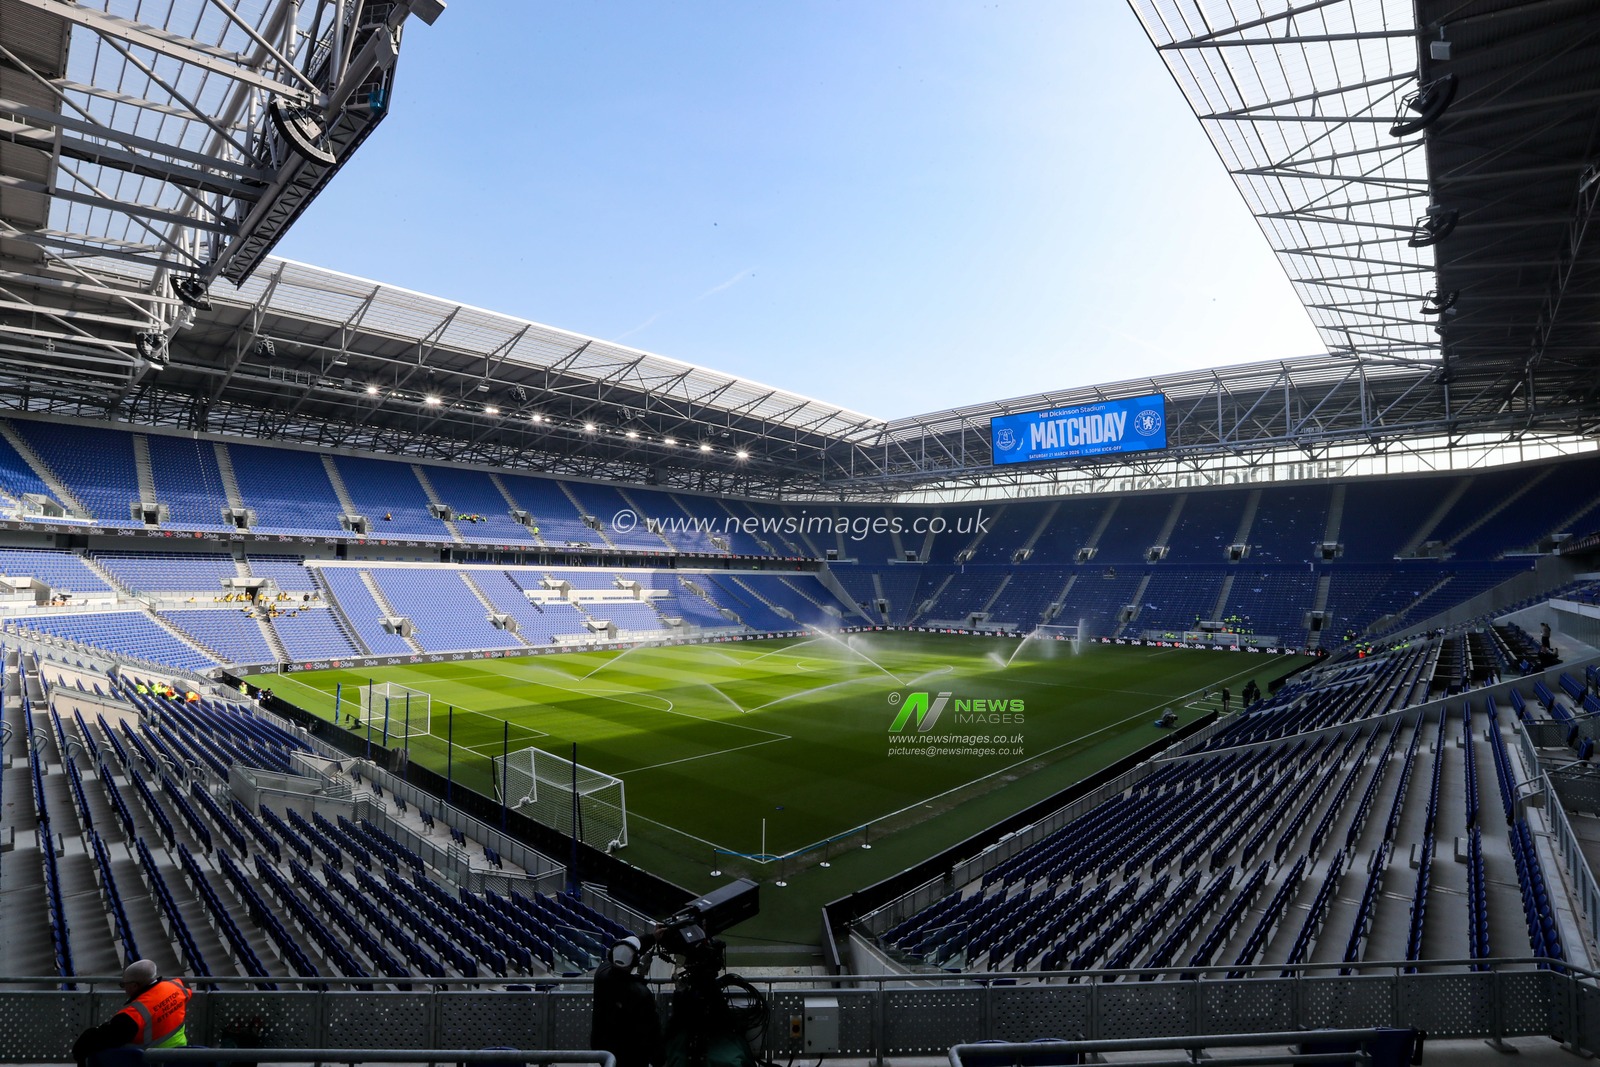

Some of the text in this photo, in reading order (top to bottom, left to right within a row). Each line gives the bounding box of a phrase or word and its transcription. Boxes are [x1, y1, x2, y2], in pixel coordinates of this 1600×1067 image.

[1050, 408, 1080, 417] Dickinson
[1080, 404, 1106, 413] Stadium
[1030, 411, 1128, 450] MATCHDAY
[153, 991, 180, 1012] EVERTON
[162, 1000, 178, 1013] HEAD
[157, 1002, 183, 1023] STEWARD
